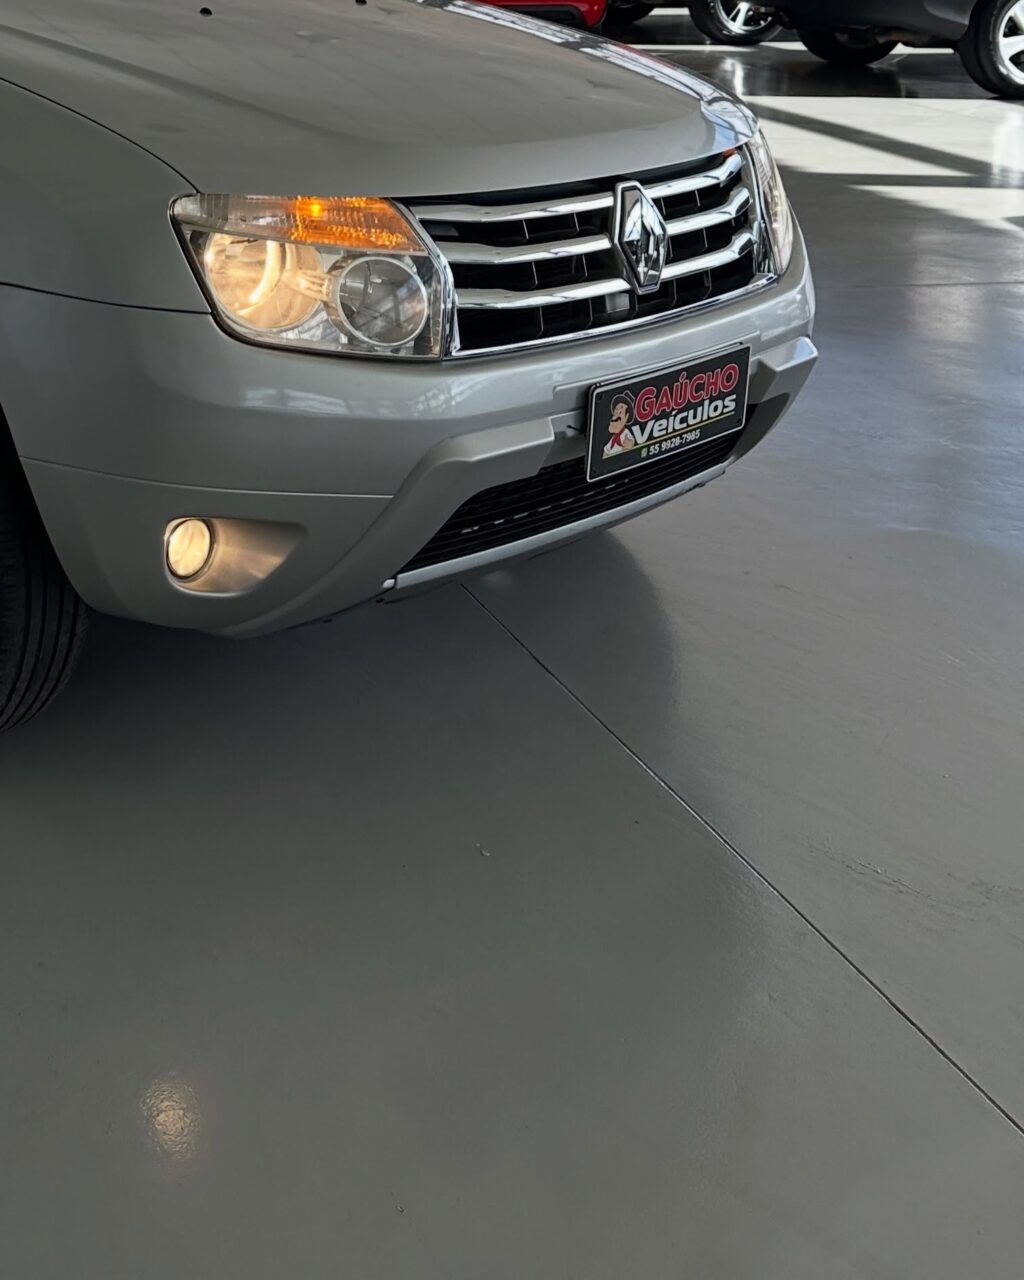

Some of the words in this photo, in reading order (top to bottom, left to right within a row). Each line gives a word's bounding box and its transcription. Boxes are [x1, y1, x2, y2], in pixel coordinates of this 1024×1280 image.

[634, 363, 740, 422] GAÚCHO
[631, 394, 737, 444] Veículos
[649, 443, 660, 456] 55
[661, 428, 701, 451] 9928-7985
